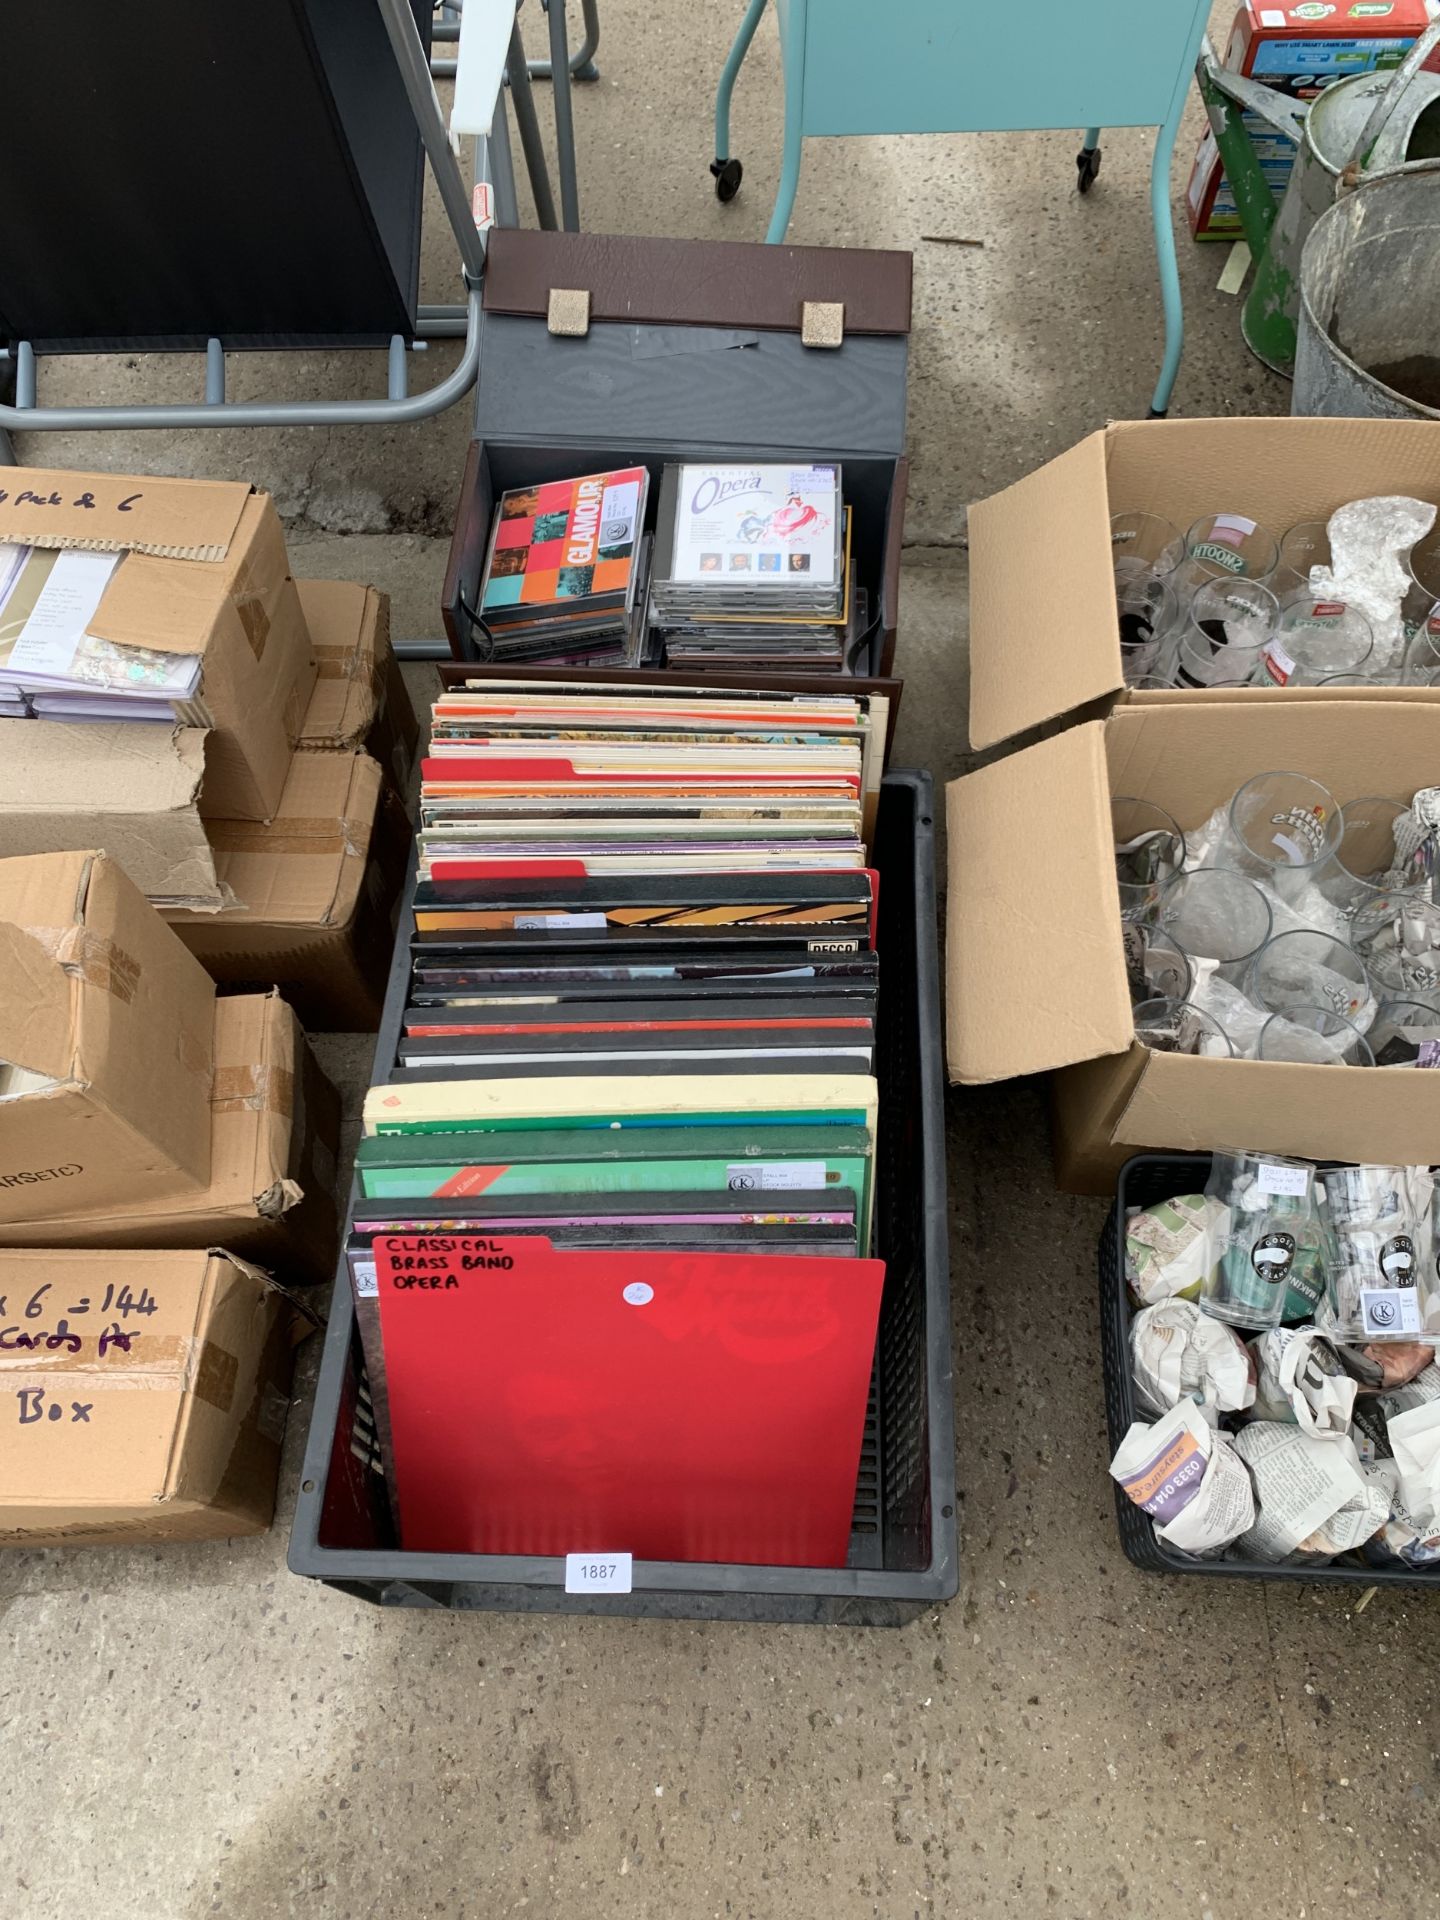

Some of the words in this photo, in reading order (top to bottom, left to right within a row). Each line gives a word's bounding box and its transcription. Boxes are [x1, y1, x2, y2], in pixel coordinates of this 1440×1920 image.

[691, 475, 762, 515] Opera
[567, 480, 601, 564] GLAMOUR
[456, 1172, 481, 1193] Edition
[386, 1238, 503, 1252] CLASSICAL
[1265, 1237, 1294, 1249] GOOSE
[390, 1256, 449, 1270] BRASS
[461, 1255, 514, 1270] BAND
[1260, 1266, 1288, 1279] ISLAND
[393, 1274, 459, 1290] OPERA
[25, 1283, 52, 1318] 6
[101, 1283, 158, 1318] 144
[16, 1386, 94, 1424] Box
[1173, 1460, 1200, 1487] 0333
[1154, 1484, 1175, 1505] 014
[580, 1564, 617, 1579] 1887
